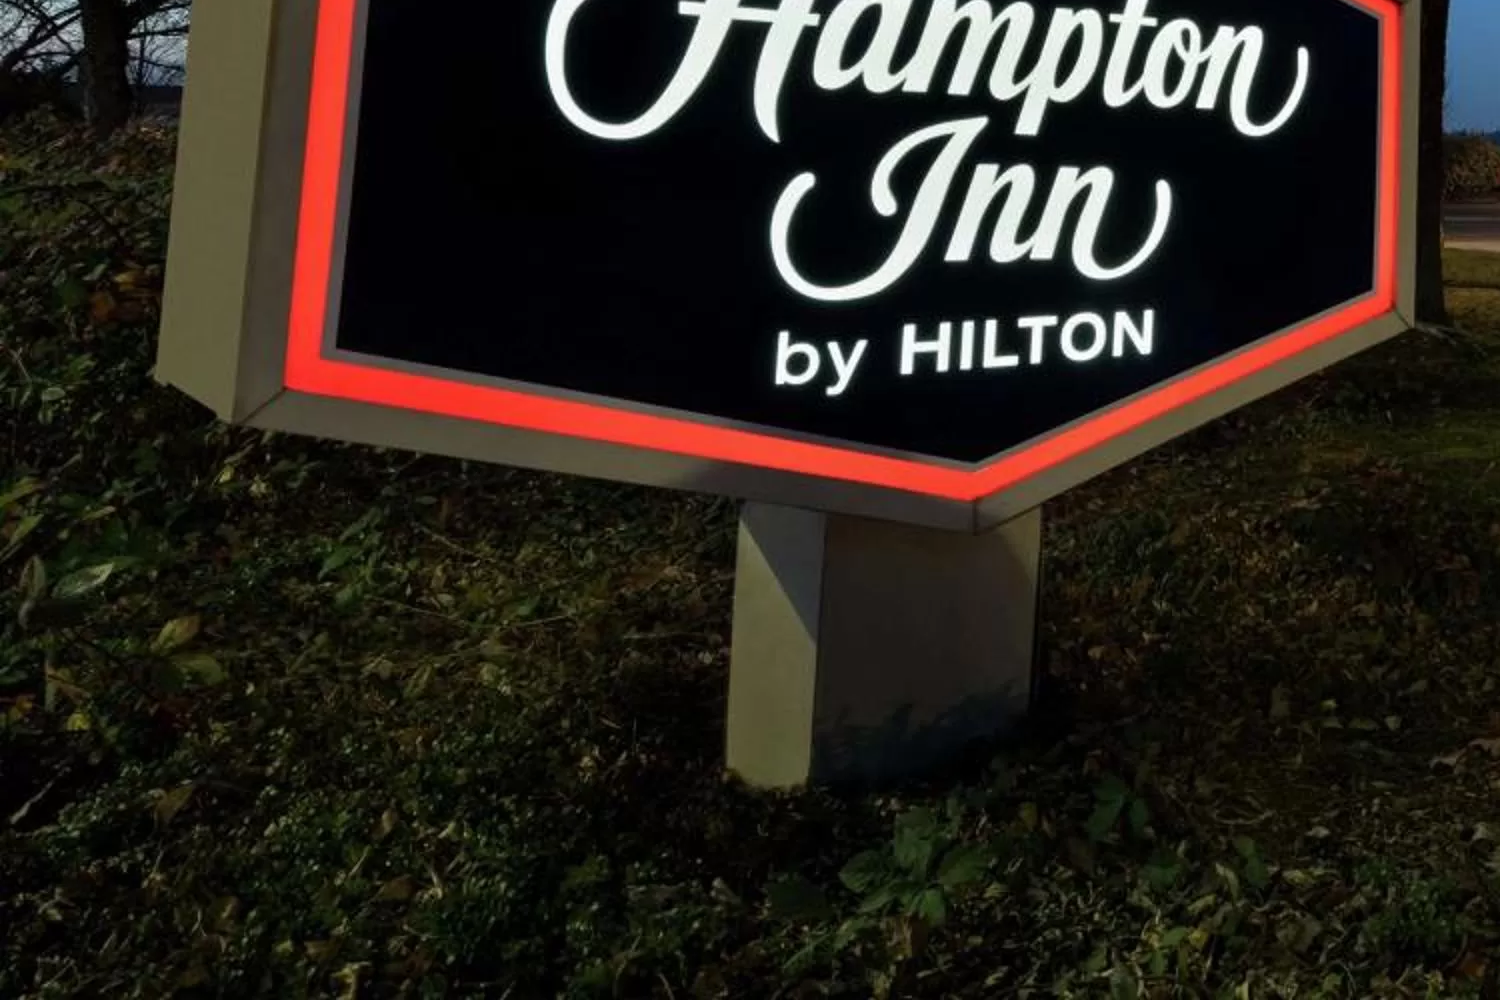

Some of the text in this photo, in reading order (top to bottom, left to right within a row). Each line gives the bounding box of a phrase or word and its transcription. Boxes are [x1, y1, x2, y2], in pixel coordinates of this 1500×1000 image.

[769, 117, 1173, 302] Inn
[774, 308, 1155, 397] by HILTON
